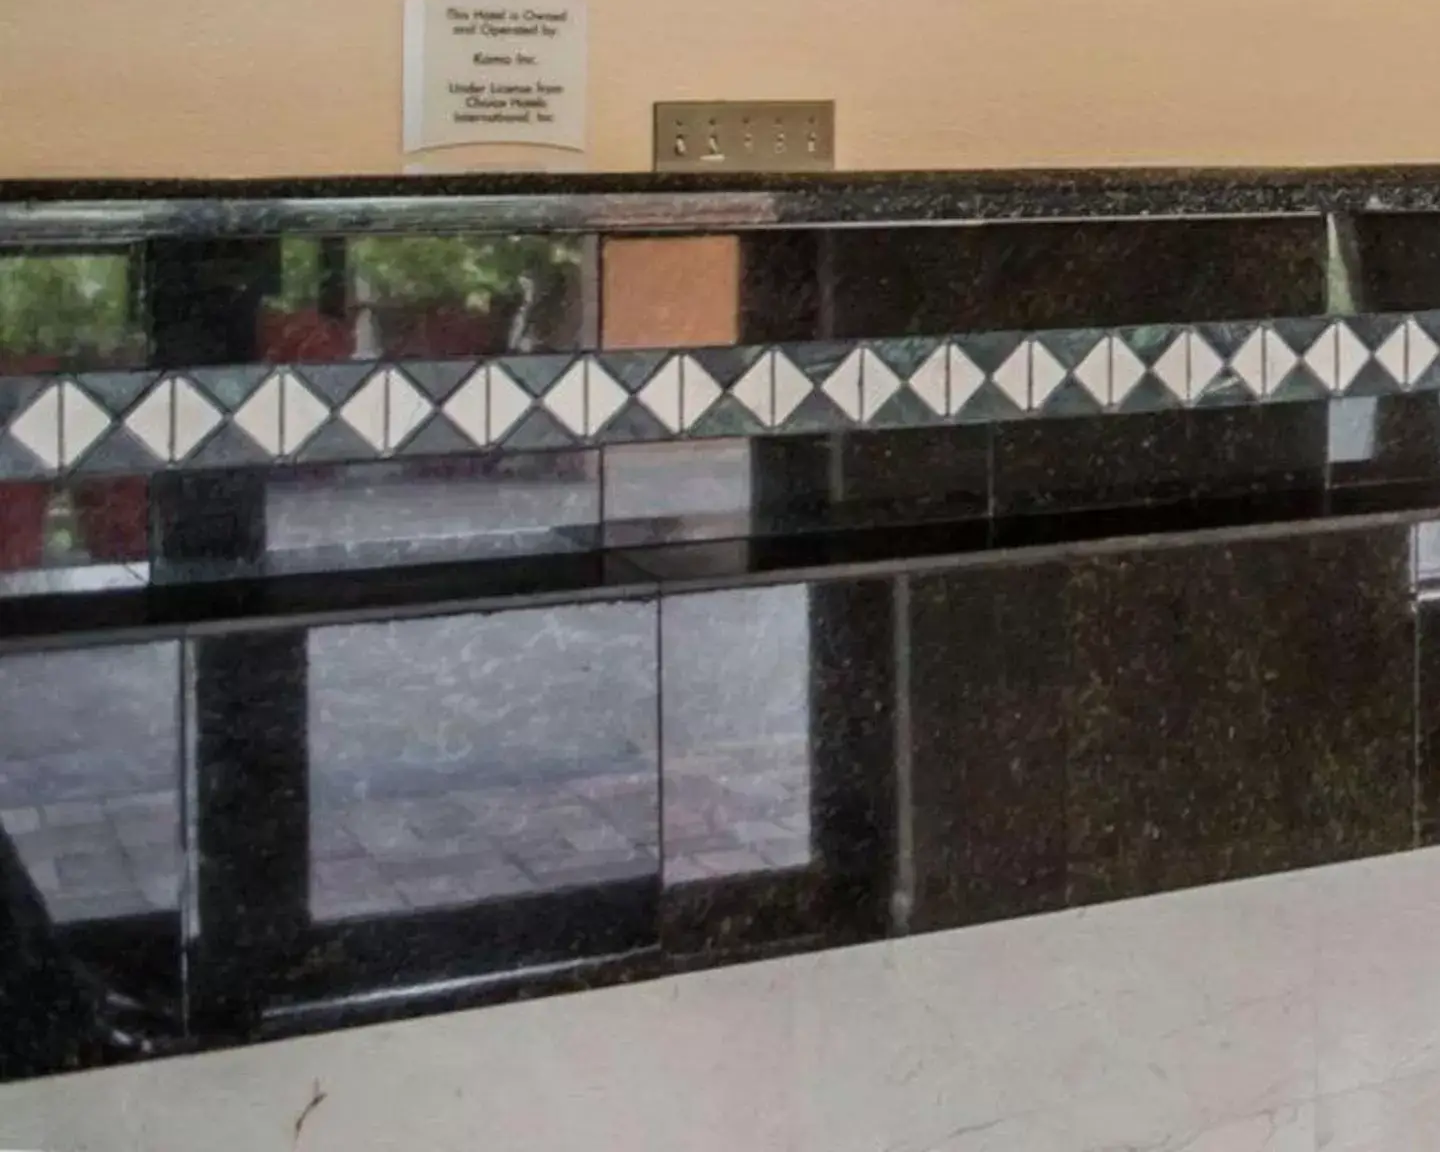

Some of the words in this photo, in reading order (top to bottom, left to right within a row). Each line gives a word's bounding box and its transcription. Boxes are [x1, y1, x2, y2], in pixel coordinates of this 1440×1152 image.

[473, 8, 506, 20] Hotel
[509, 9, 519, 20] is
[522, 8, 568, 21] Owned
[452, 24, 476, 36] and
[480, 23, 538, 37] Operated
[448, 81, 486, 94] Under
[489, 81, 532, 94] License
[464, 96, 507, 108] Choice
[509, 96, 547, 108] Hotels
